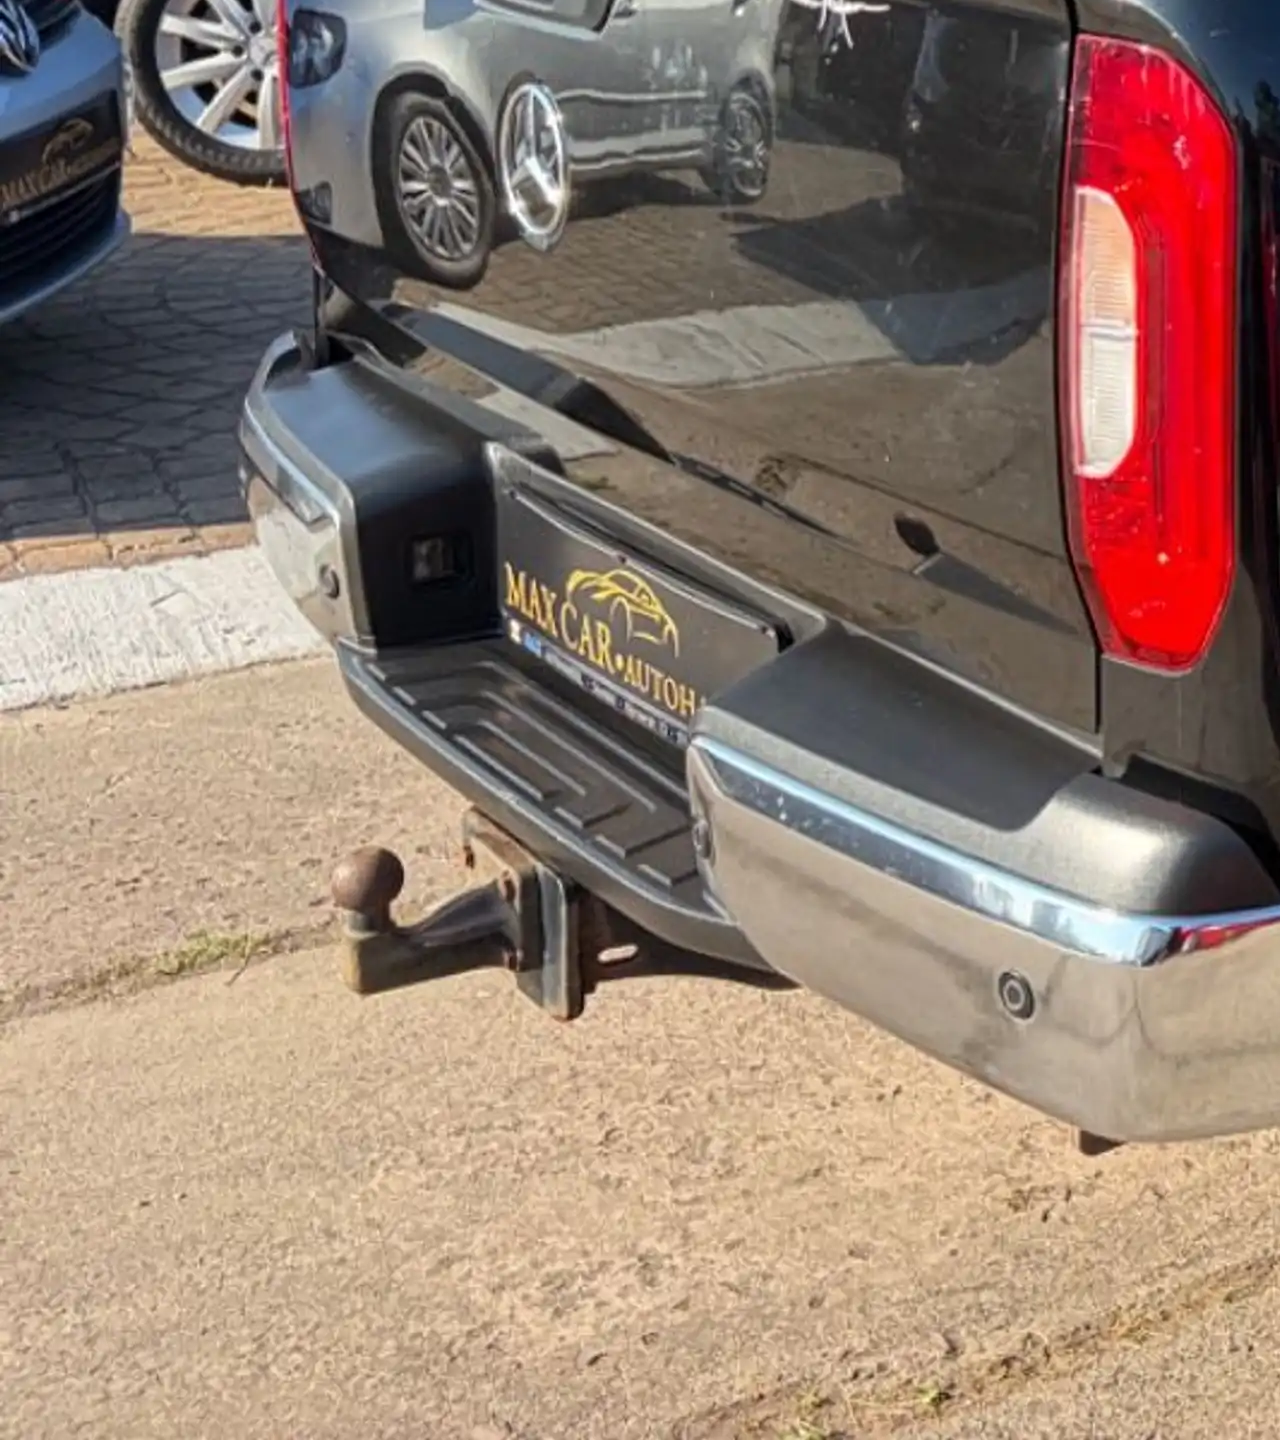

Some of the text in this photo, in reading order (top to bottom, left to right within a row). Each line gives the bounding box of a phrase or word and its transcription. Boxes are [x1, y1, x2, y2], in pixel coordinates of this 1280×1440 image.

[505, 561, 560, 638] MAX
[561, 601, 616, 675] CAR
[624, 656, 704, 717] AUTOH
